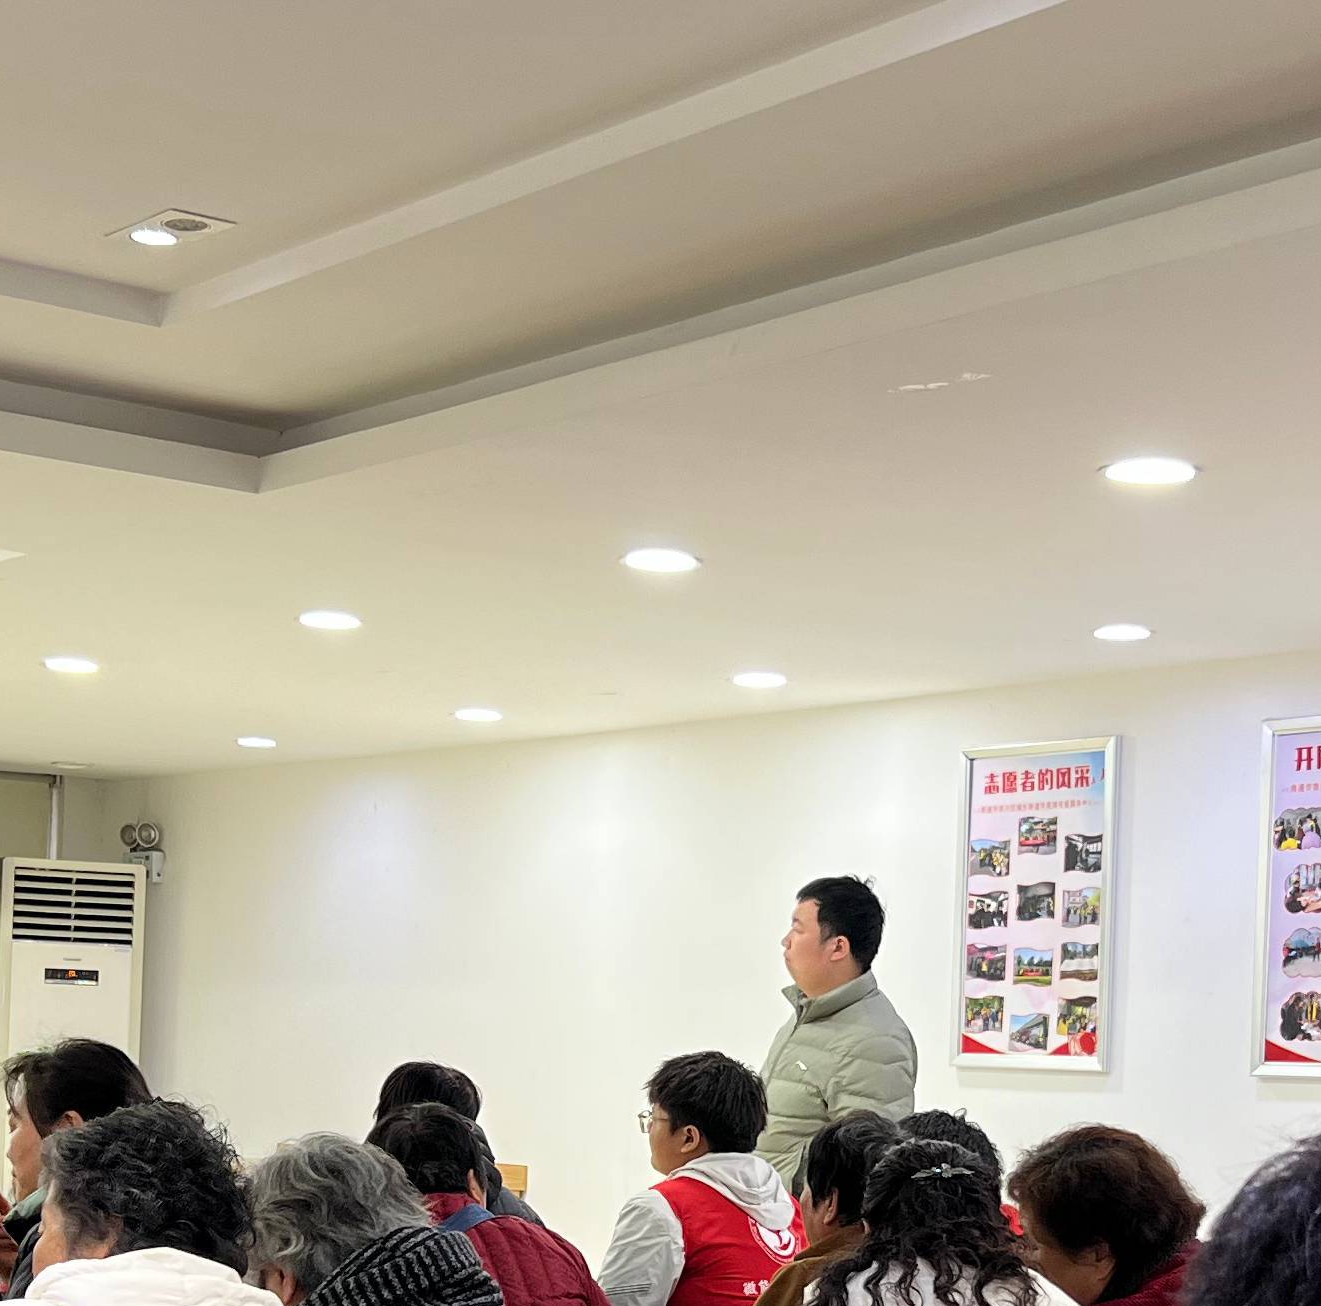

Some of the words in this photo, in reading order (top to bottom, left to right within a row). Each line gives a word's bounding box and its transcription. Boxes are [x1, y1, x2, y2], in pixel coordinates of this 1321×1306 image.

[984, 765, 1091, 795] 志愿者的风采
